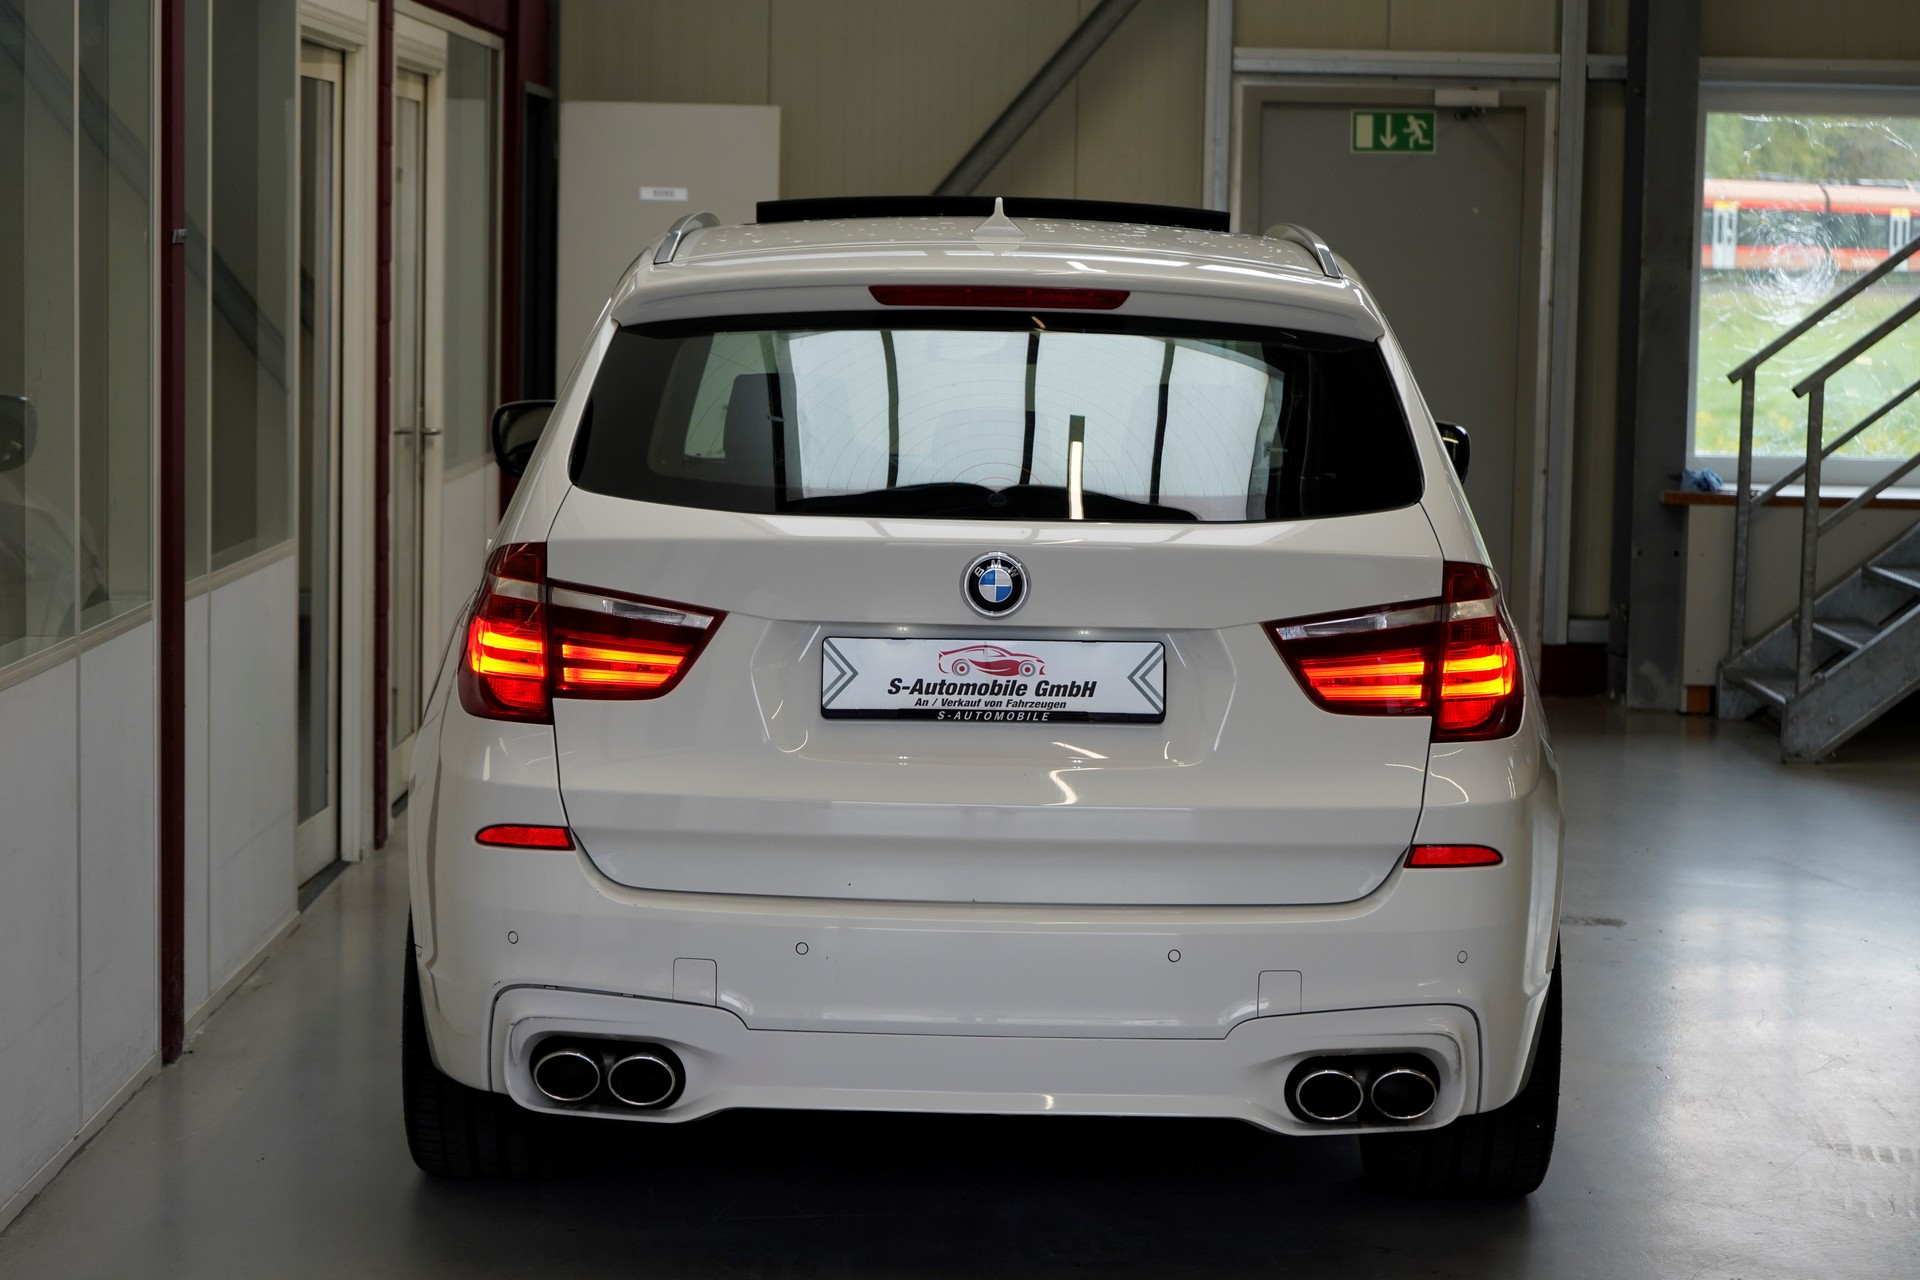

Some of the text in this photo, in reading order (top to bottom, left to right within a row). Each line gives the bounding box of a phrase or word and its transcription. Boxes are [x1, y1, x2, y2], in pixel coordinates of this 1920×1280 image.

[974, 559, 1019, 578] BMW
[887, 677, 1097, 698] S-Automobile GmbH
[914, 698, 1067, 710] An / Verkauf von Fahrzeugen
